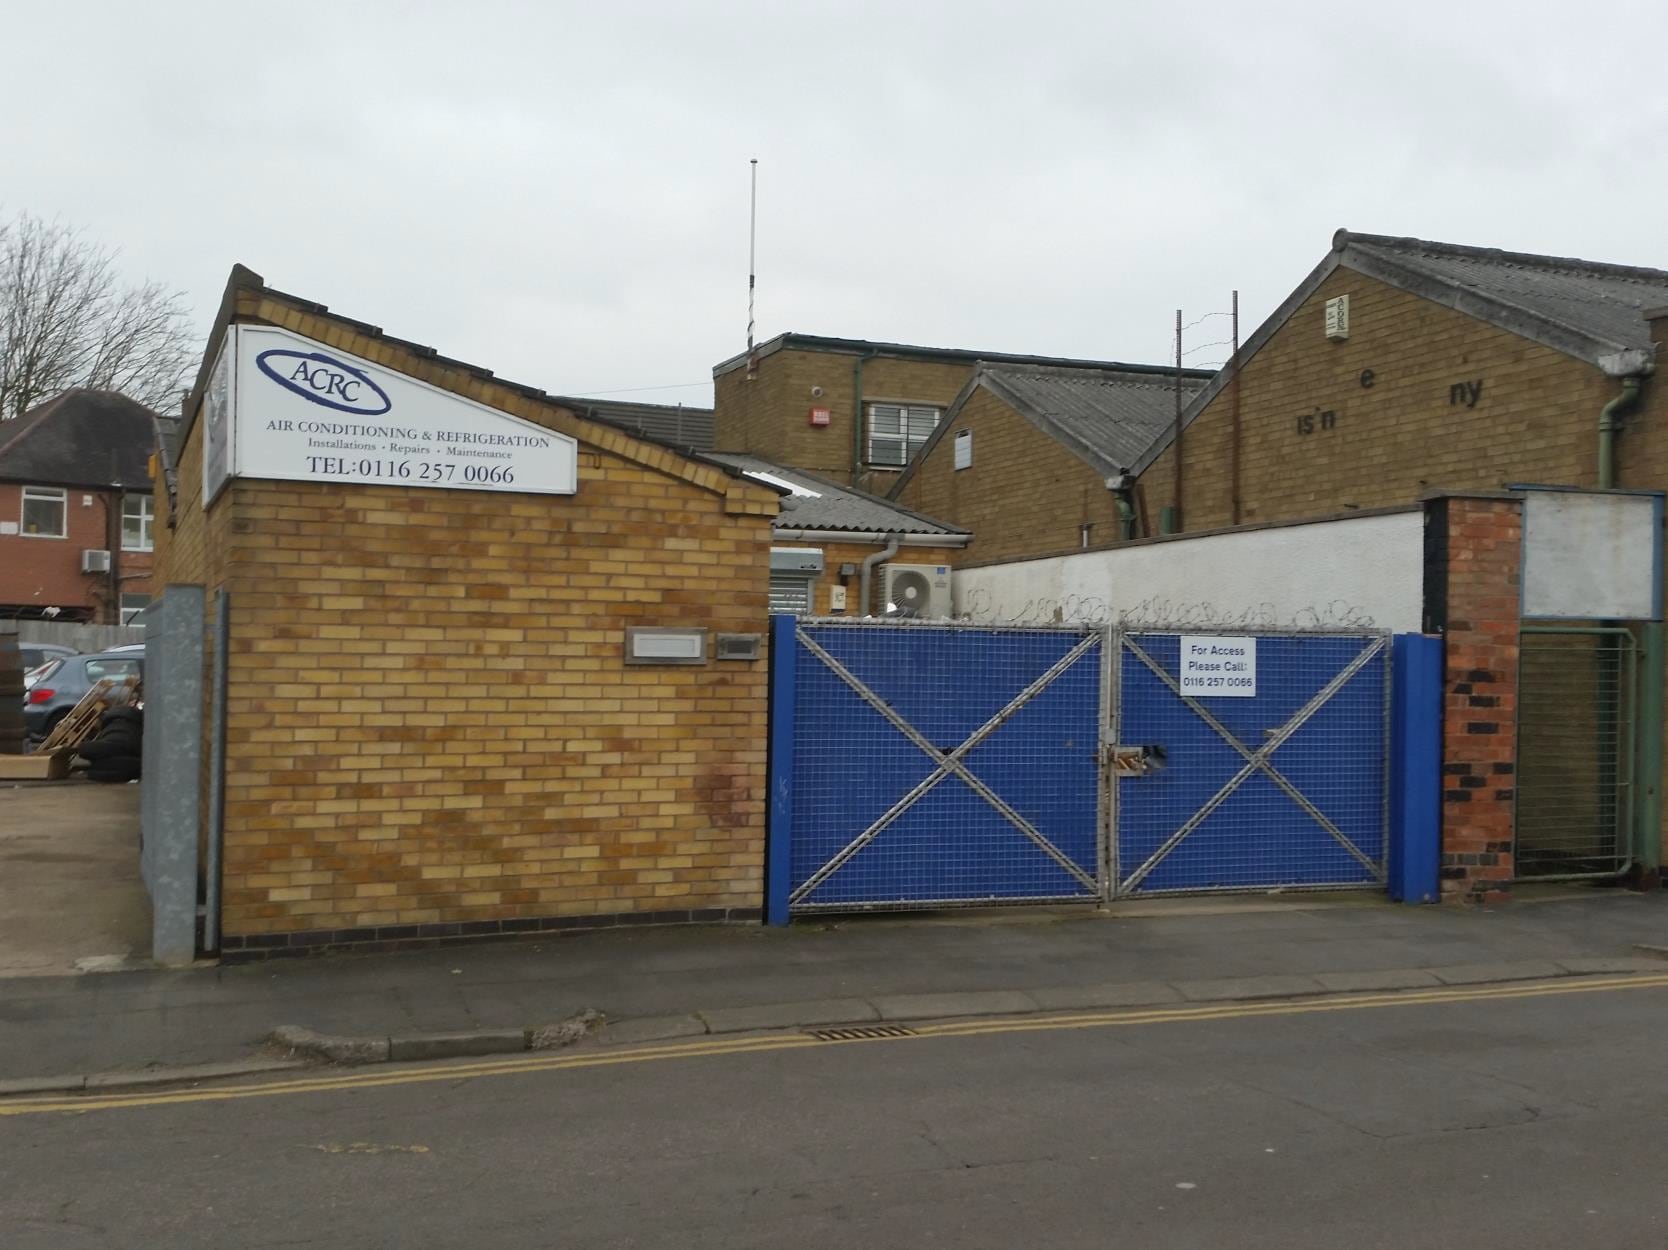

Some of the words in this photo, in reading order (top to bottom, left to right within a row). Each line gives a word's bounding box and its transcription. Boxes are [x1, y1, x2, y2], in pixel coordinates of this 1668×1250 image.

[290, 360, 361, 402] ACRC
[266, 420, 294, 432] AIR
[298, 421, 418, 440] CONDITIONING
[421, 430, 432, 441] &
[436, 431, 550, 448] REFRIGERATION
[308, 438, 377, 451] Installations
[389, 442, 431, 455] Repairs
[446, 446, 513, 460] Maintenance
[306, 455, 411, 479] TEL:0116
[419, 462, 456, 481] 257
[464, 465, 515, 484] 0066
[1191, 645, 1207, 655] For
[1210, 645, 1245, 656] Access
[1188, 661, 1221, 671] Please
[1224, 661, 1247, 672] Call:
[1183, 677, 1205, 687] 0116
[1207, 677, 1225, 687] 257
[1227, 677, 1253, 687] 0066
